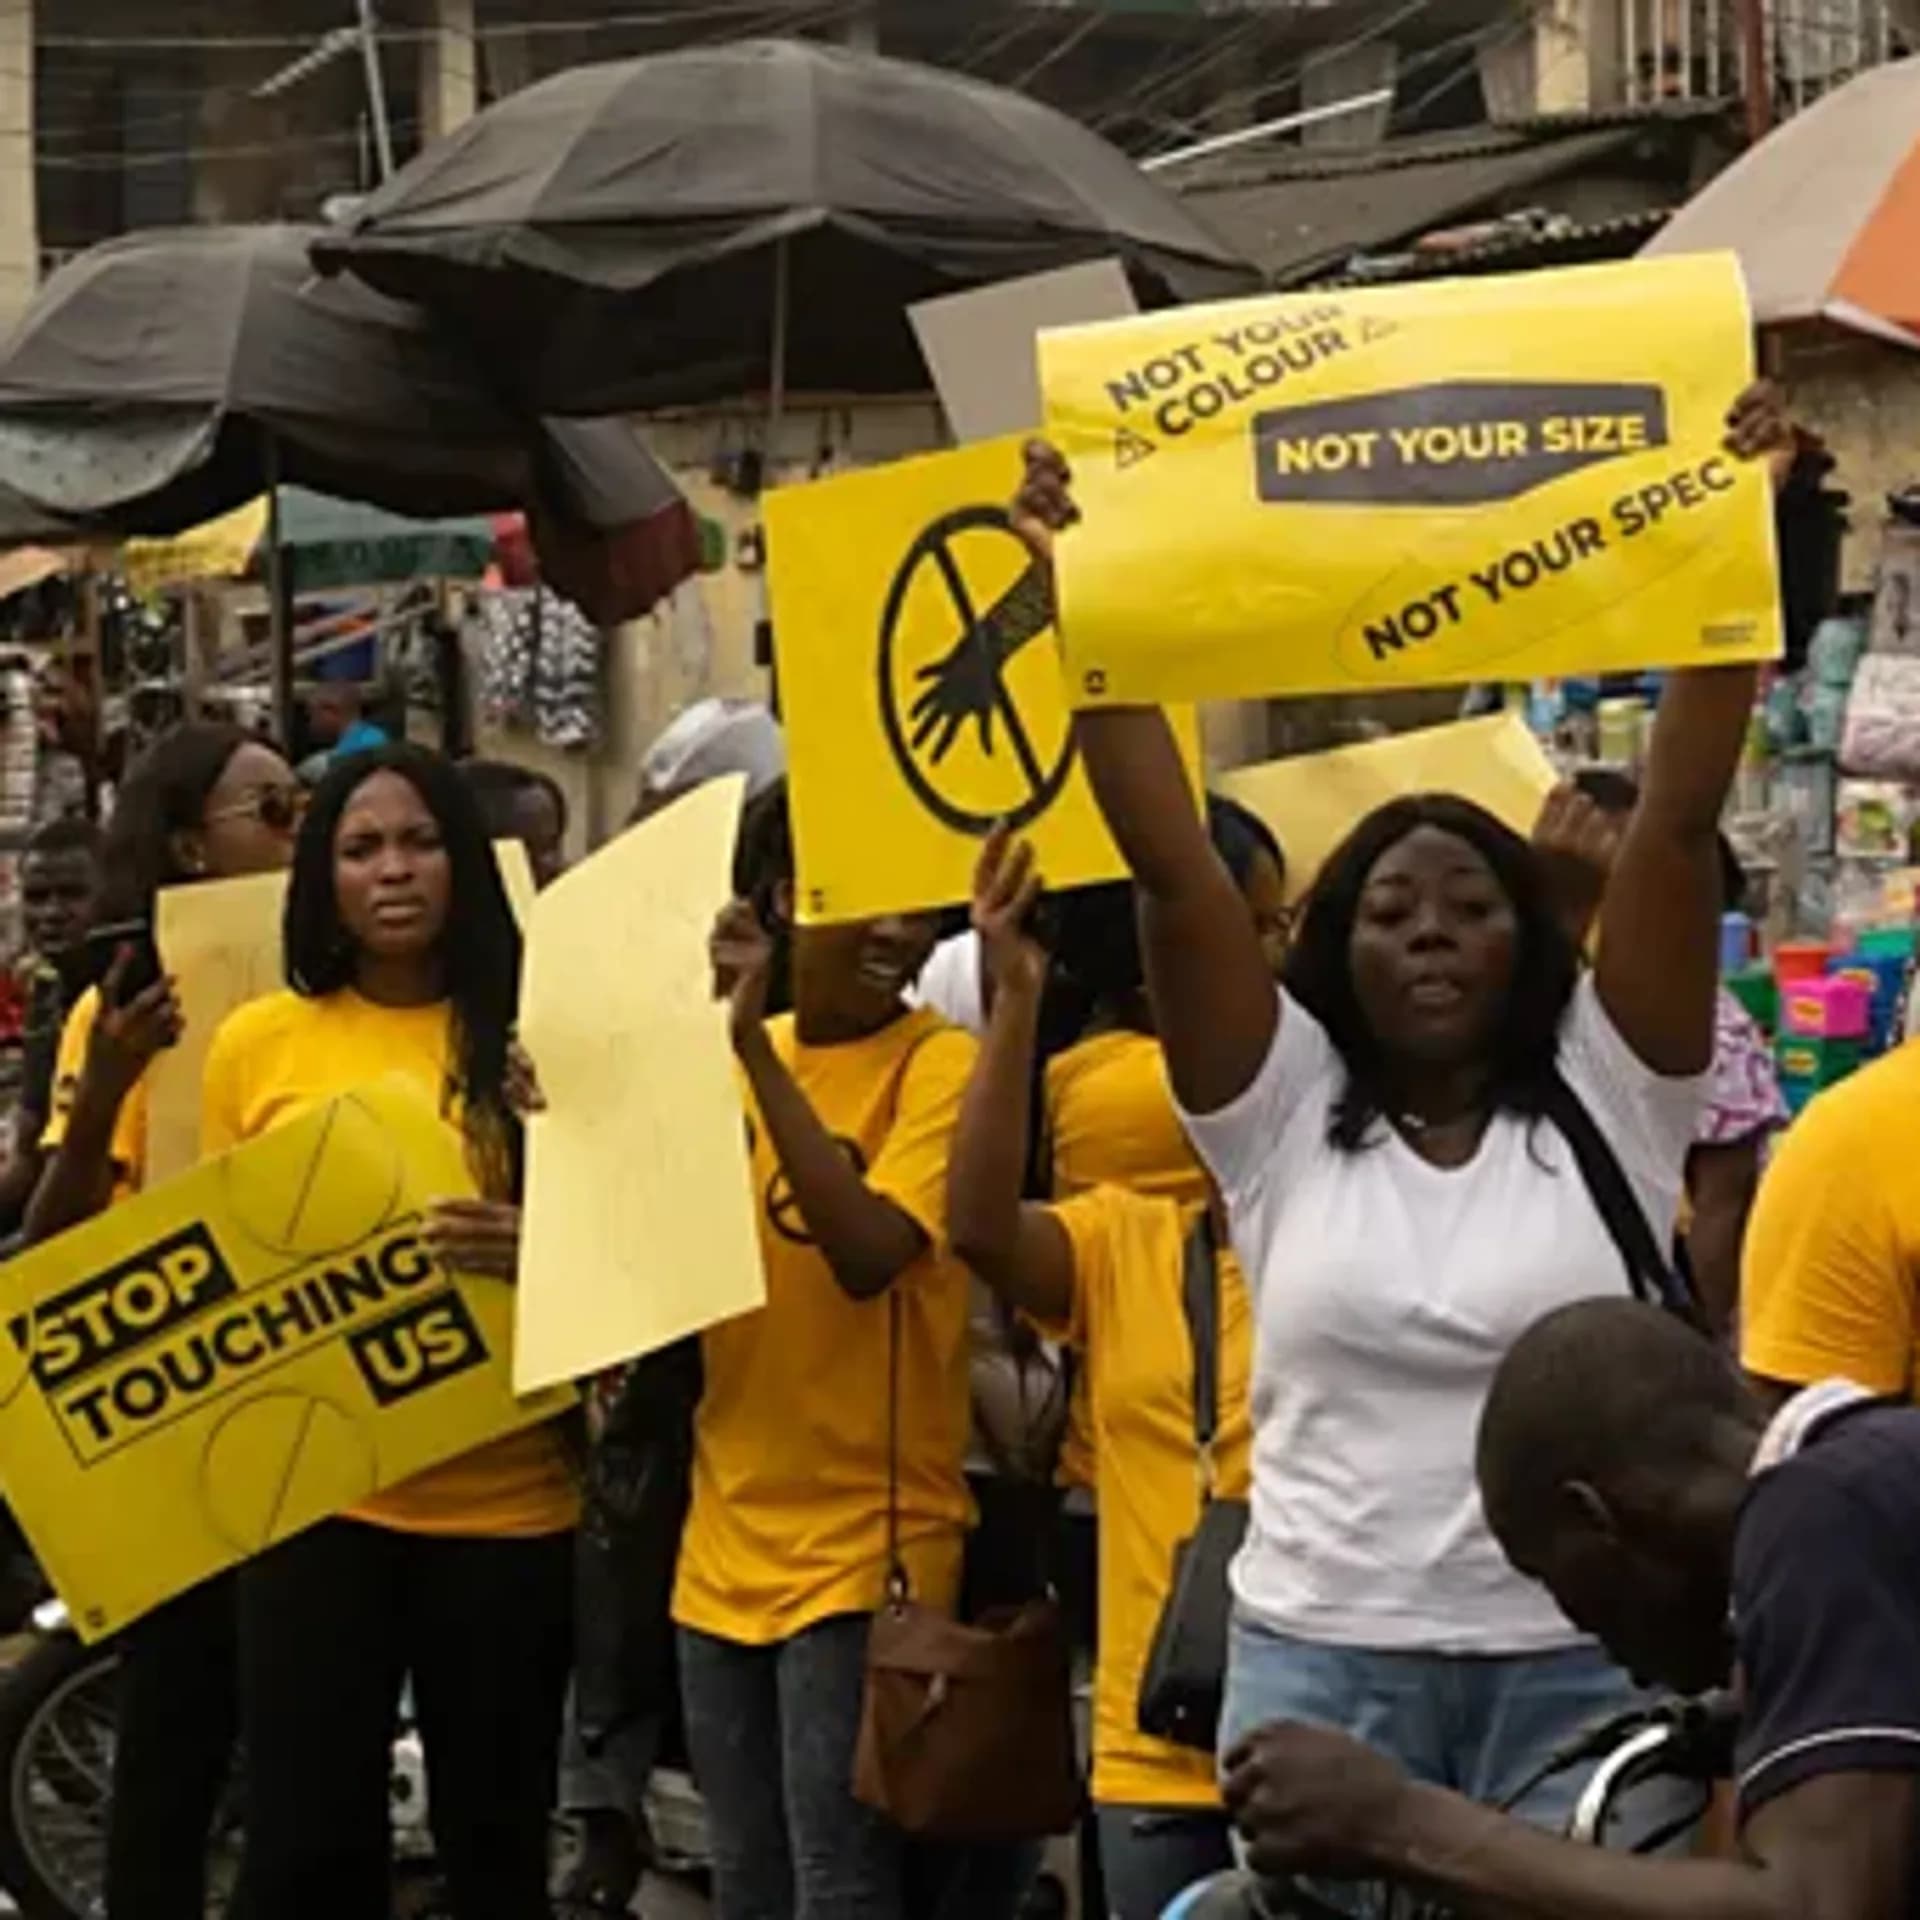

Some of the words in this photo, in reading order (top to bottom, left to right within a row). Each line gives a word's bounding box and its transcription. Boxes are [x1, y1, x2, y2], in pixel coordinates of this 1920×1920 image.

[1105, 343, 1204, 413] NOT
[1155, 328, 1350, 436] COLOUR
[1276, 432, 1381, 475] NOT
[1389, 421, 1530, 464] YOUR
[1541, 414, 1648, 453] SIZE
[1362, 583, 1462, 661] NOT
[1468, 516, 1607, 604] YOUR
[1611, 458, 1735, 537] SPEC
[37, 1243, 212, 1374] STOP
[67, 1235, 432, 1443] TOUCHING
[363, 1308, 470, 1387] US
